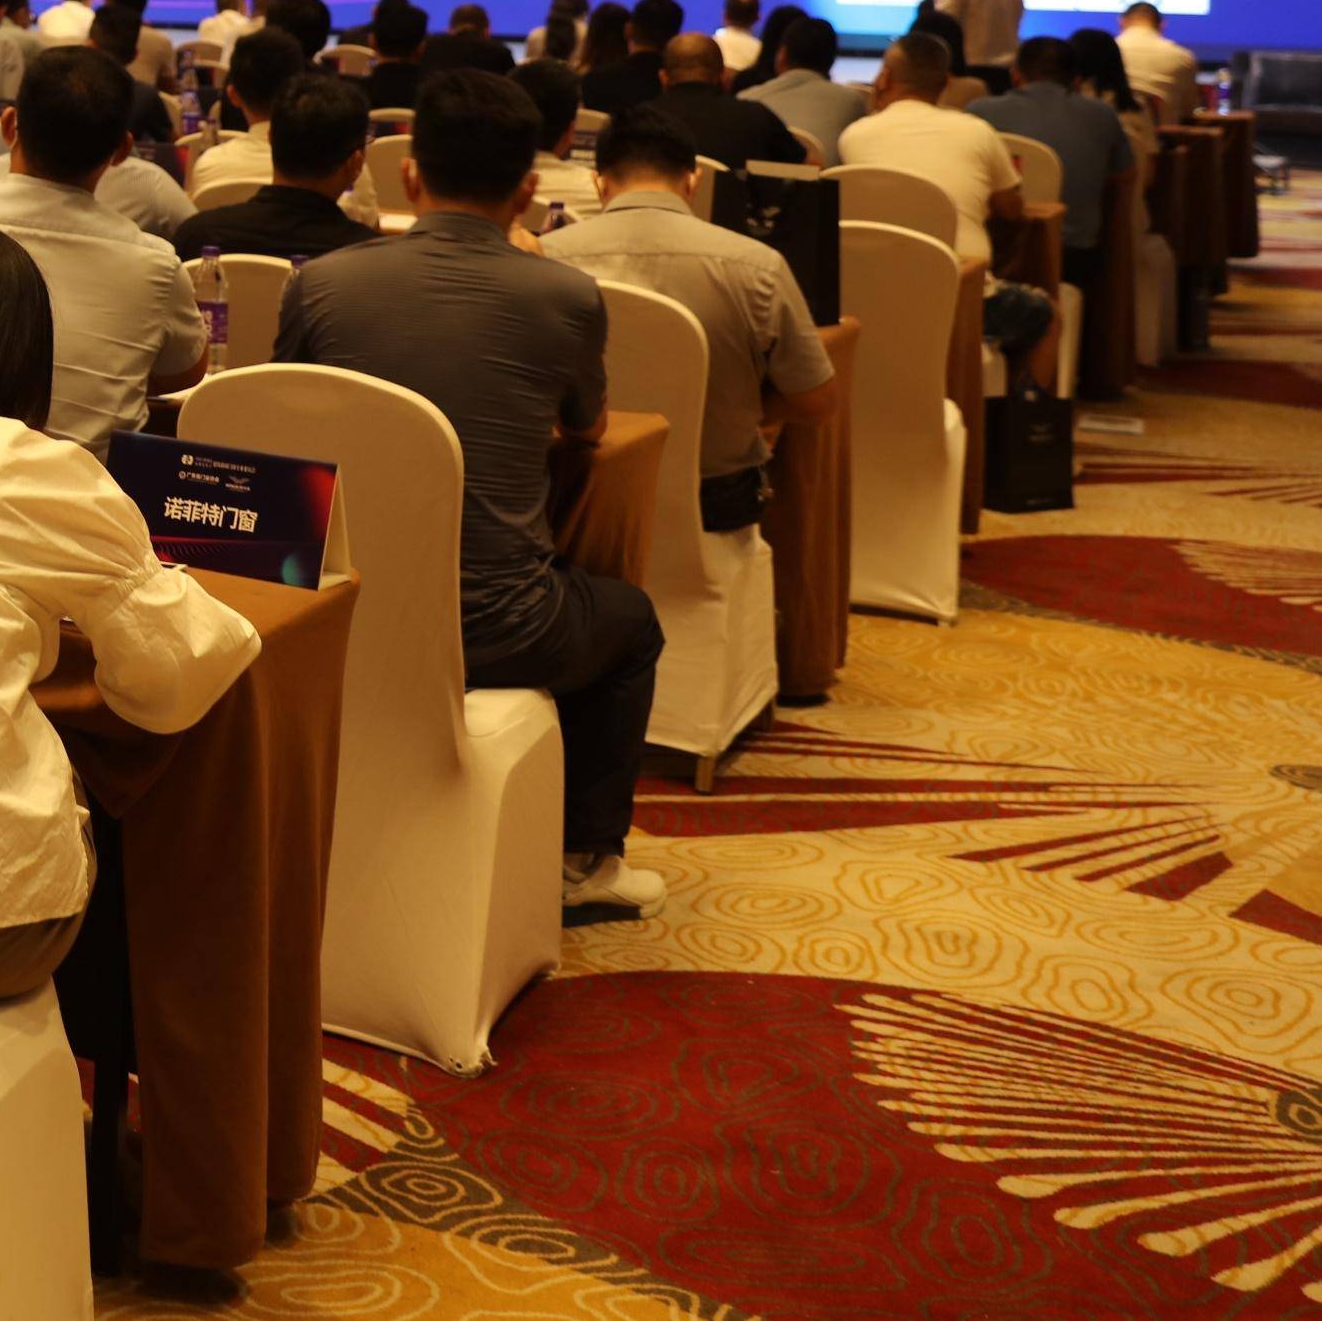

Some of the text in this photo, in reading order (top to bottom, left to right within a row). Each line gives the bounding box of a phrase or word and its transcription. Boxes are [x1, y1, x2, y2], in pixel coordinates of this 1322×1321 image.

[163, 496, 259, 533] 诺菲特门窗
